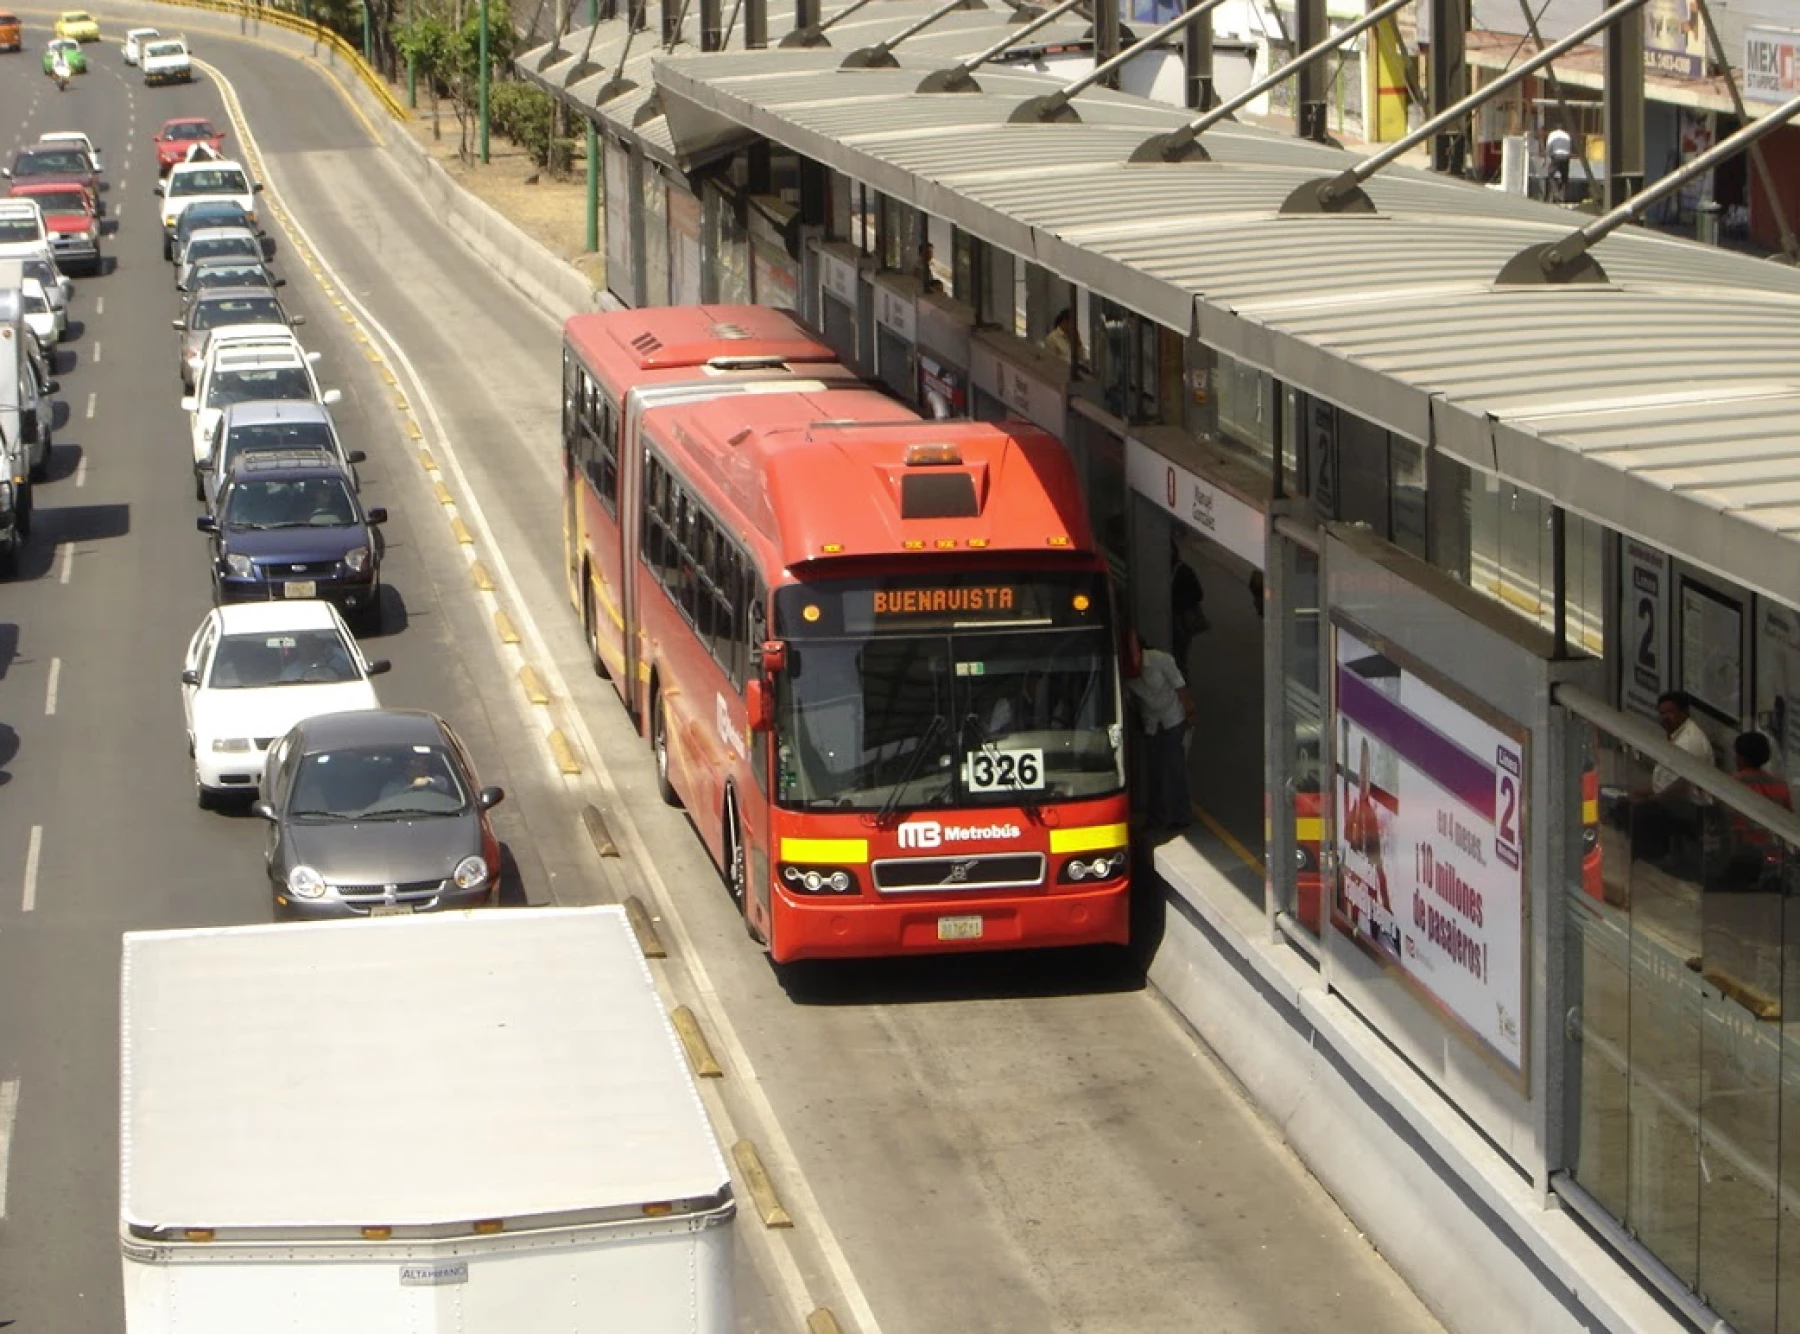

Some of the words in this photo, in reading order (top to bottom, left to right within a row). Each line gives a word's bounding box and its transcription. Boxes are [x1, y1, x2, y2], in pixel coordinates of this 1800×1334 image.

[1747, 40, 1778, 75] MEX
[1638, 597, 1656, 670] 2
[974, 753, 1038, 787] 326
[1500, 775, 1515, 845] 2
[898, 821, 941, 849] MB
[944, 823, 1021, 842] Metrobús
[1413, 887, 1426, 933] de
[1435, 861, 1484, 929] millones
